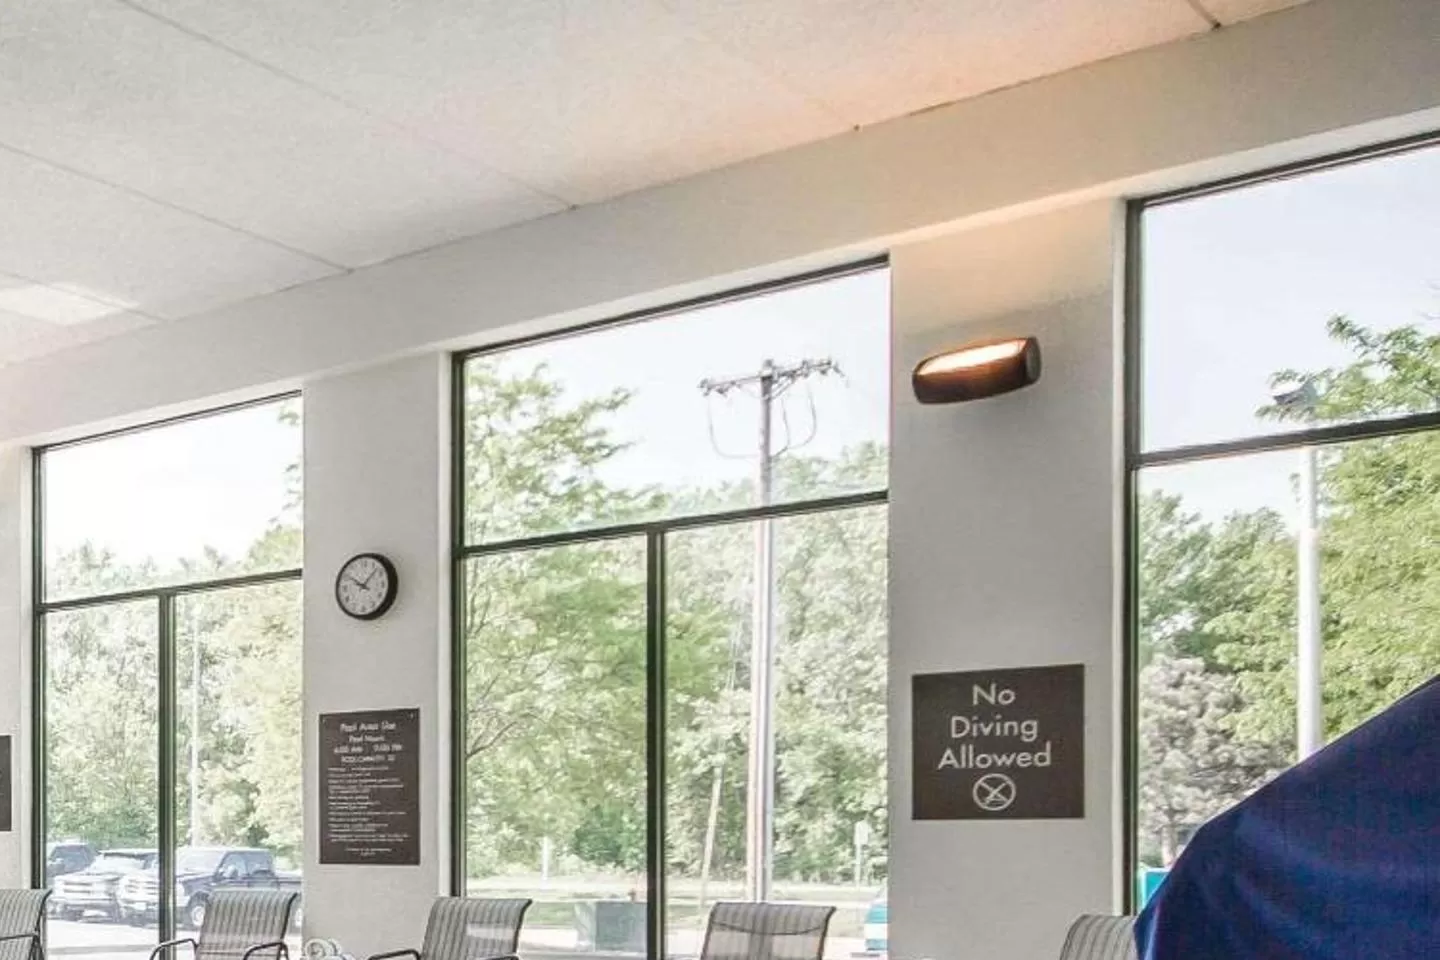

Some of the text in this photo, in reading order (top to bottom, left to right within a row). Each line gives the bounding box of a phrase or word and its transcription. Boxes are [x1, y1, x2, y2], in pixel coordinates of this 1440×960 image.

[972, 683, 1016, 706] No
[951, 714, 1039, 742] Diving
[937, 740, 1052, 770] Allowed
